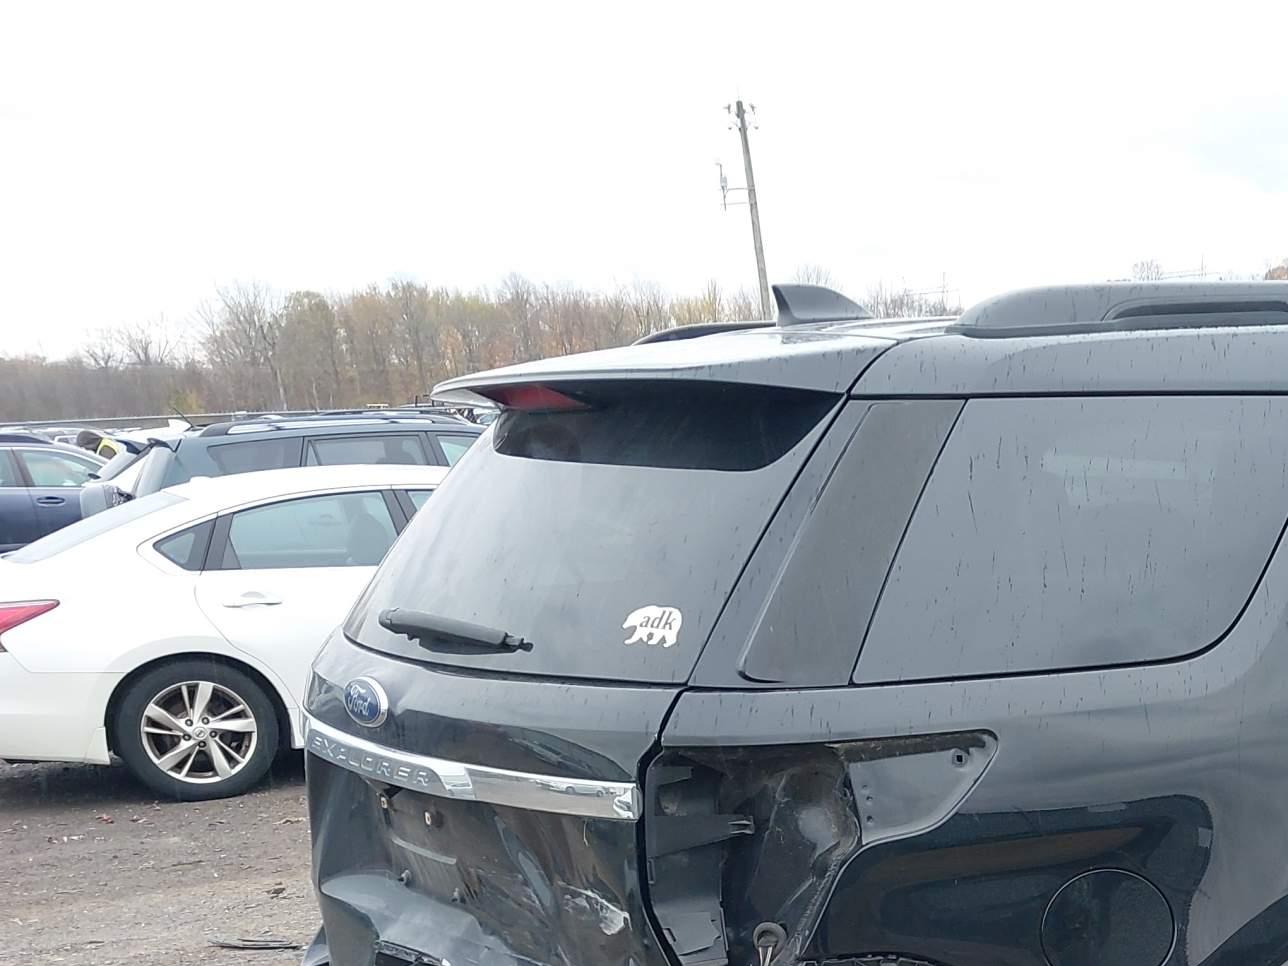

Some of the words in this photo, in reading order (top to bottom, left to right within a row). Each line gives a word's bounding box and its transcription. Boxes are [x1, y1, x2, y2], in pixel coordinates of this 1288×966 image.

[639, 609, 677, 631] adk
[347, 683, 372, 716] Ford
[311, 736, 430, 787] EXPLORER
